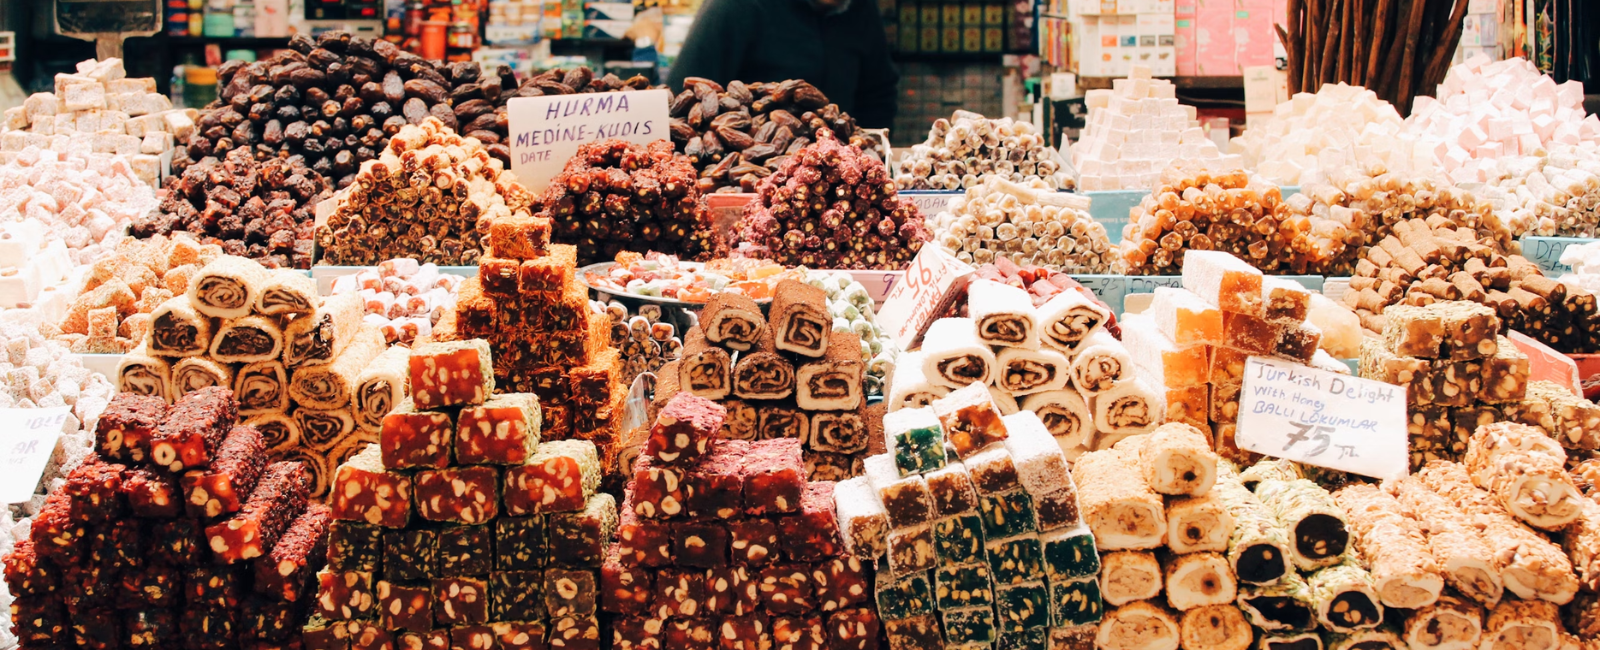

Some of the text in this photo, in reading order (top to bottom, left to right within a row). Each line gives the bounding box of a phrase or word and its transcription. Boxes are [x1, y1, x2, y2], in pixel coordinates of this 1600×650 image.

[545, 94, 629, 121] HURMA
[520, 150, 552, 165] DATE
[905, 250, 932, 300] 95
[1251, 360, 1394, 404] Turkish Delight
[1252, 400, 1294, 418] BALLI
[1292, 393, 1325, 412] Honey
[1282, 420, 1336, 458] 75
